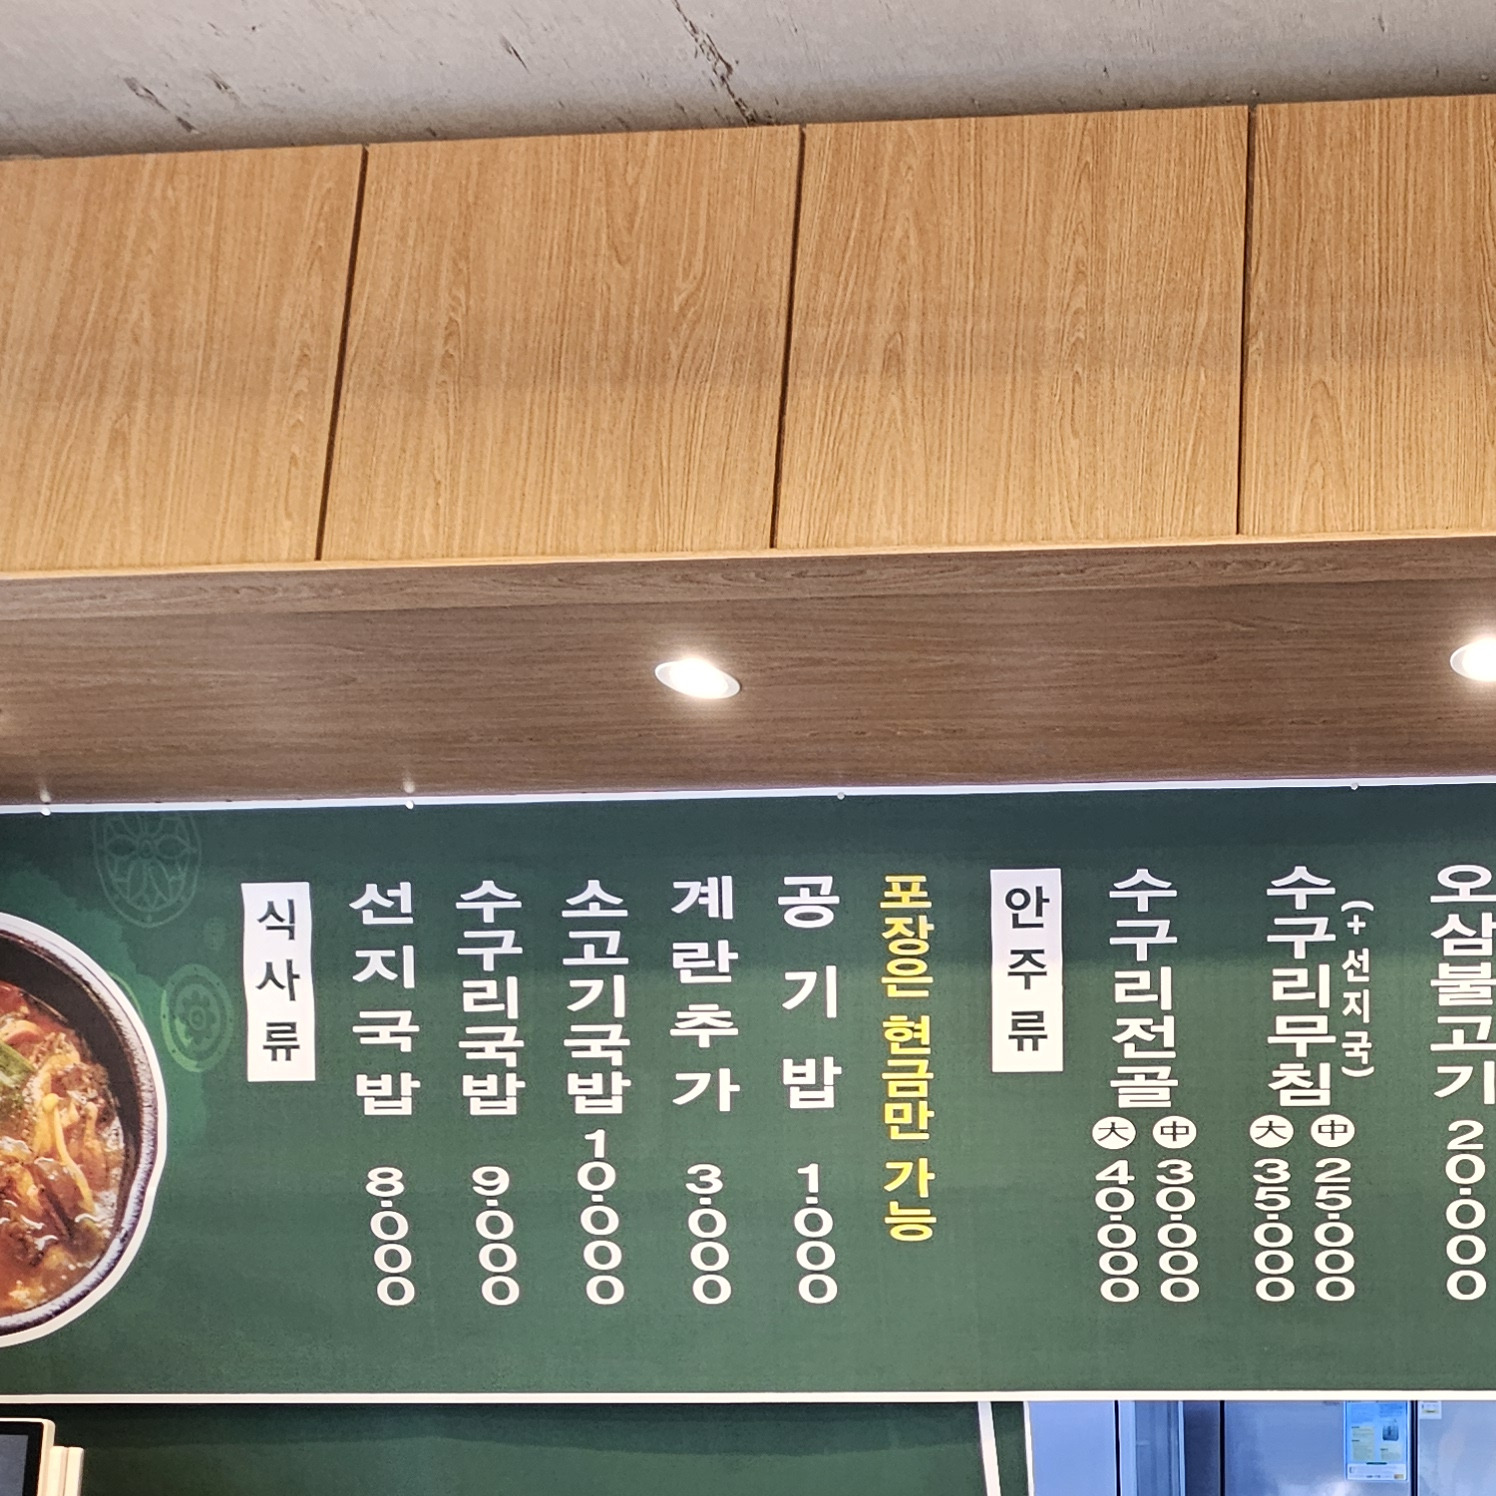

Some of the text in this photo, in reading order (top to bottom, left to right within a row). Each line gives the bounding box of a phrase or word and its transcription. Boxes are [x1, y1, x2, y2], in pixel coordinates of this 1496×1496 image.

[257, 899, 300, 1061] 식사류
[879, 875, 937, 1242] 포장은 현금만 가능
[1005, 885, 1050, 1052] 안주류
[1109, 868, 1179, 1109] 수구리전골
[1266, 865, 1337, 1107] 수구리무침
[348, 881, 421, 1307] 선지국밥 8.000
[455, 880, 526, 1306] 수구리국밥 9.000
[561, 879, 632, 1306] 소고기국밥 10.000
[669, 875, 741, 1305] 계란추가 3.000
[777, 875, 843, 1305] 공기밥 1.000
[1252, 1115, 1295, 1302] 大 35.000
[1313, 1119, 1356, 1302] 中 25.000
[1445, 1119, 1487, 1301] 20.000
[1094, 1121, 1140, 1303] 大 40.000
[1155, 1120, 1200, 1303] 中 30.000
